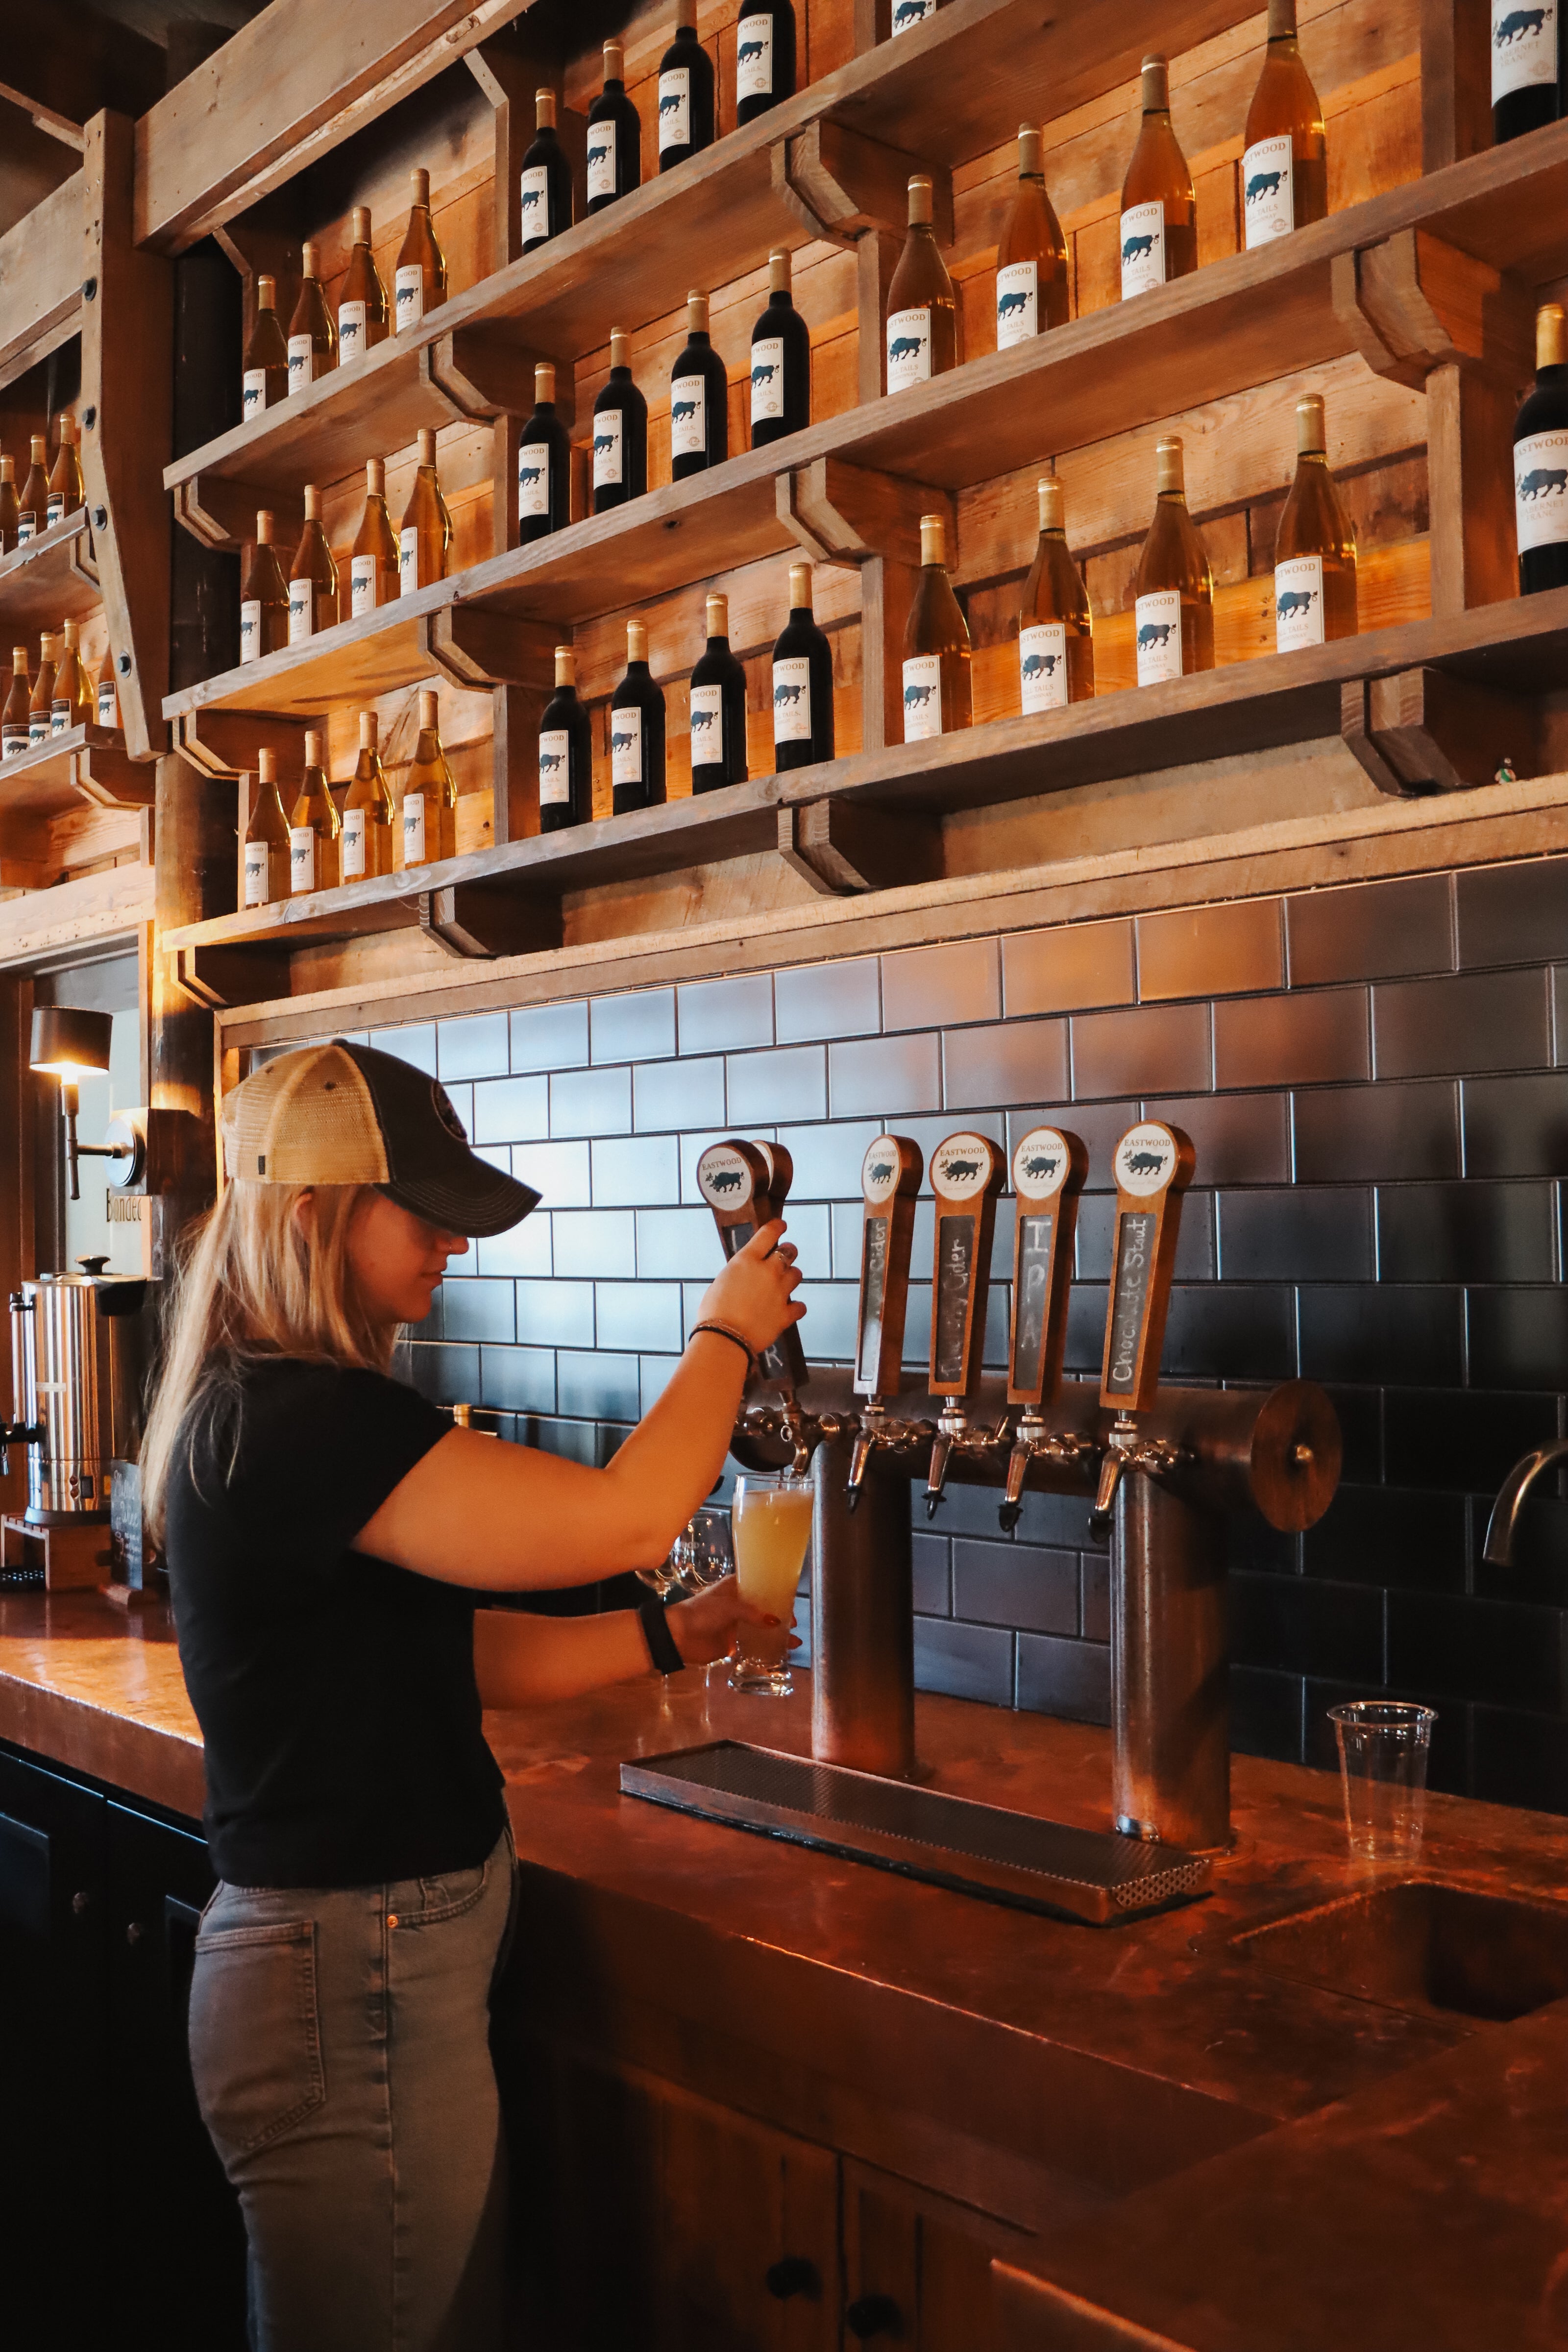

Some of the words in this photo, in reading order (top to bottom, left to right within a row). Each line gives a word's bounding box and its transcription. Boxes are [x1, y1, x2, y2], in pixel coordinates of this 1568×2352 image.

[1495, 41, 1539, 61] ABERNET
[900, 364, 918, 372] TAILS
[1288, 623, 1309, 633] TAILS
[1148, 654, 1168, 663] TAILS
[1021, 1142, 1063, 1152] EASTWOOD
[1124, 1138, 1171, 1147] EASTWOOD
[868, 1150, 897, 1160] EASTWOOD
[940, 1147, 985, 1156] EASTWOOD
[702, 1156, 742, 1171] EASTWOOD
[869, 1222, 885, 1272] Cider
[943, 1239, 969, 1291] Cider
